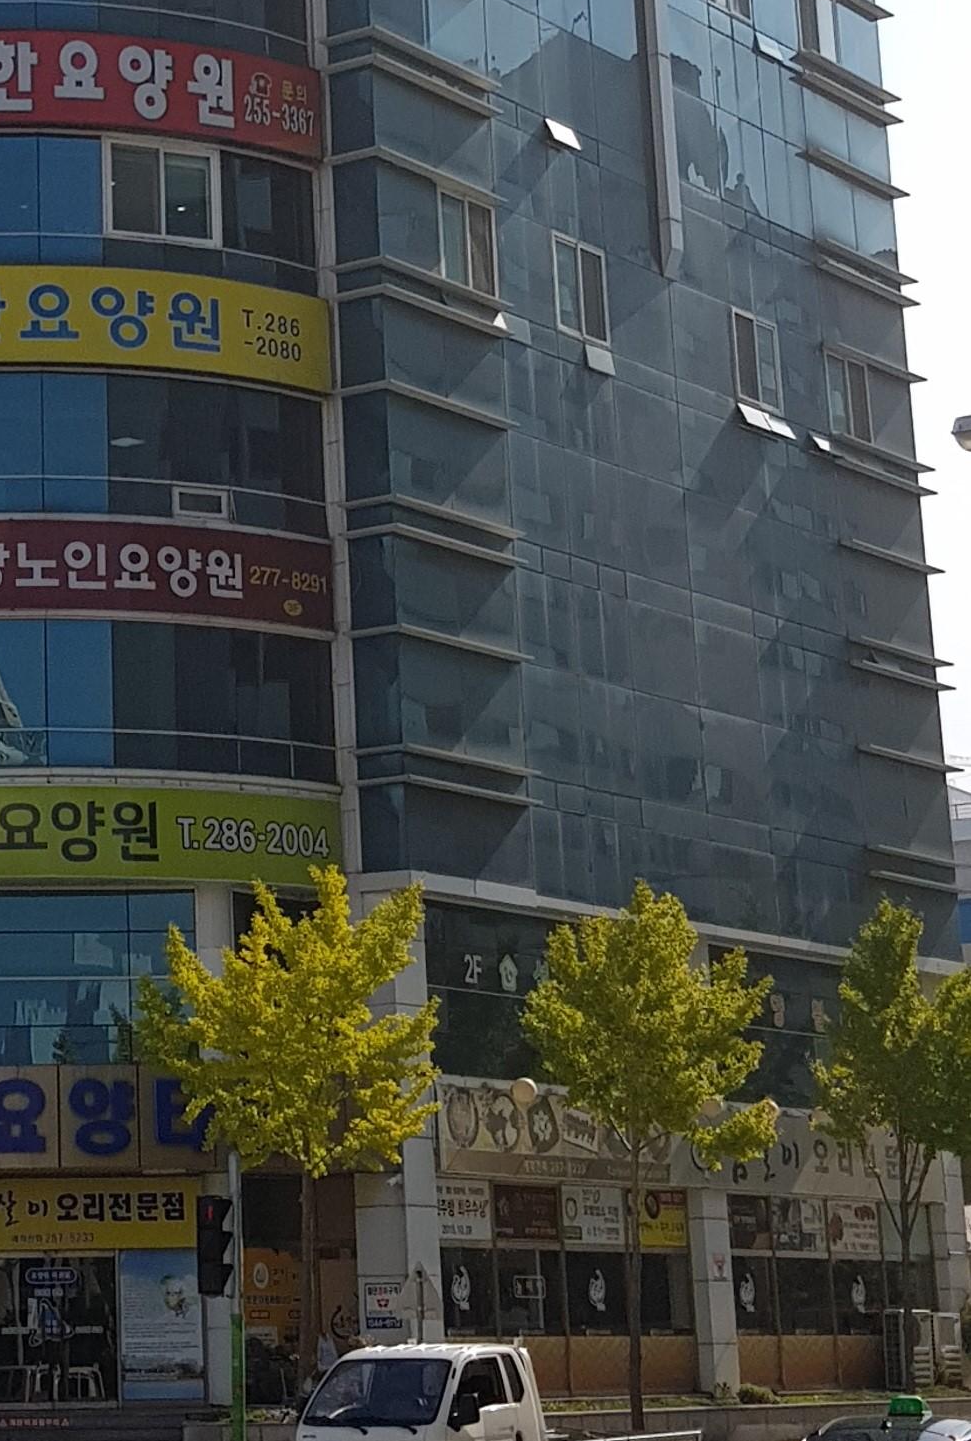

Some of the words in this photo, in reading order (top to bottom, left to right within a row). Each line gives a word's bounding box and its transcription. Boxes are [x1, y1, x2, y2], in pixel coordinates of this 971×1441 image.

[282, 80, 308, 105] 문의
[244, 94, 315, 137] 255-3367
[241, 309, 302, 338] T.286
[249, 564, 328, 596] 277-8291
[464, 953, 482, 984] 2F
[55, 1191, 186, 1223] 오리전문점
